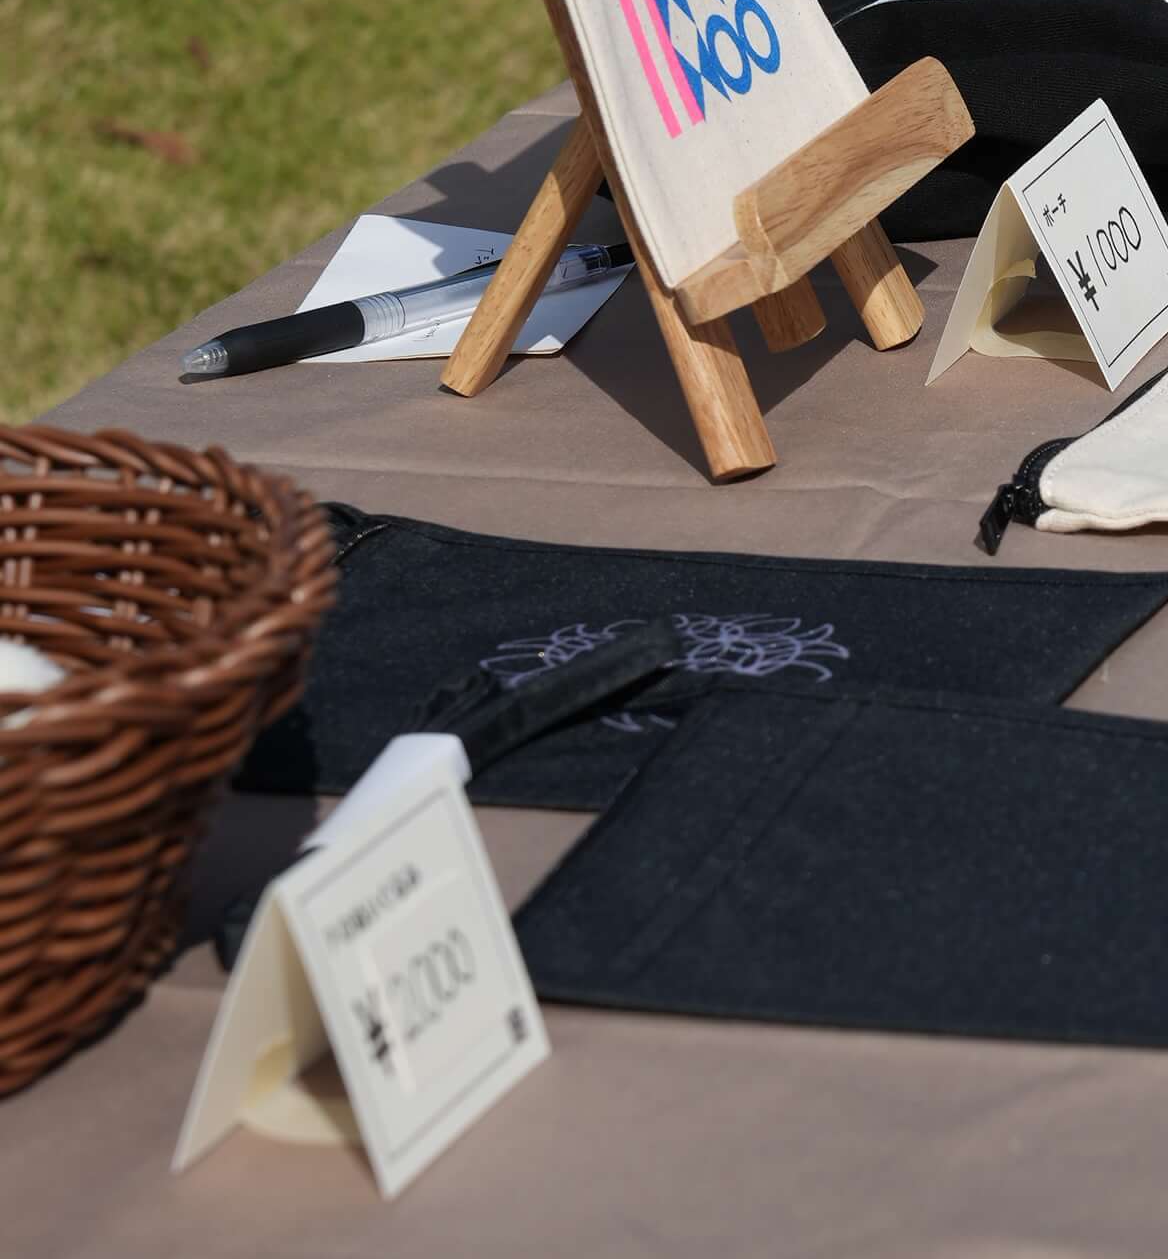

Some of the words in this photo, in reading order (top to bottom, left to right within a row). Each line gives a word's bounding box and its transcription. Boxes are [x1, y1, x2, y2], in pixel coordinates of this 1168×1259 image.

[1042, 193, 1067, 227] ポーチ
[1066, 206, 1142, 312] ¥1000
